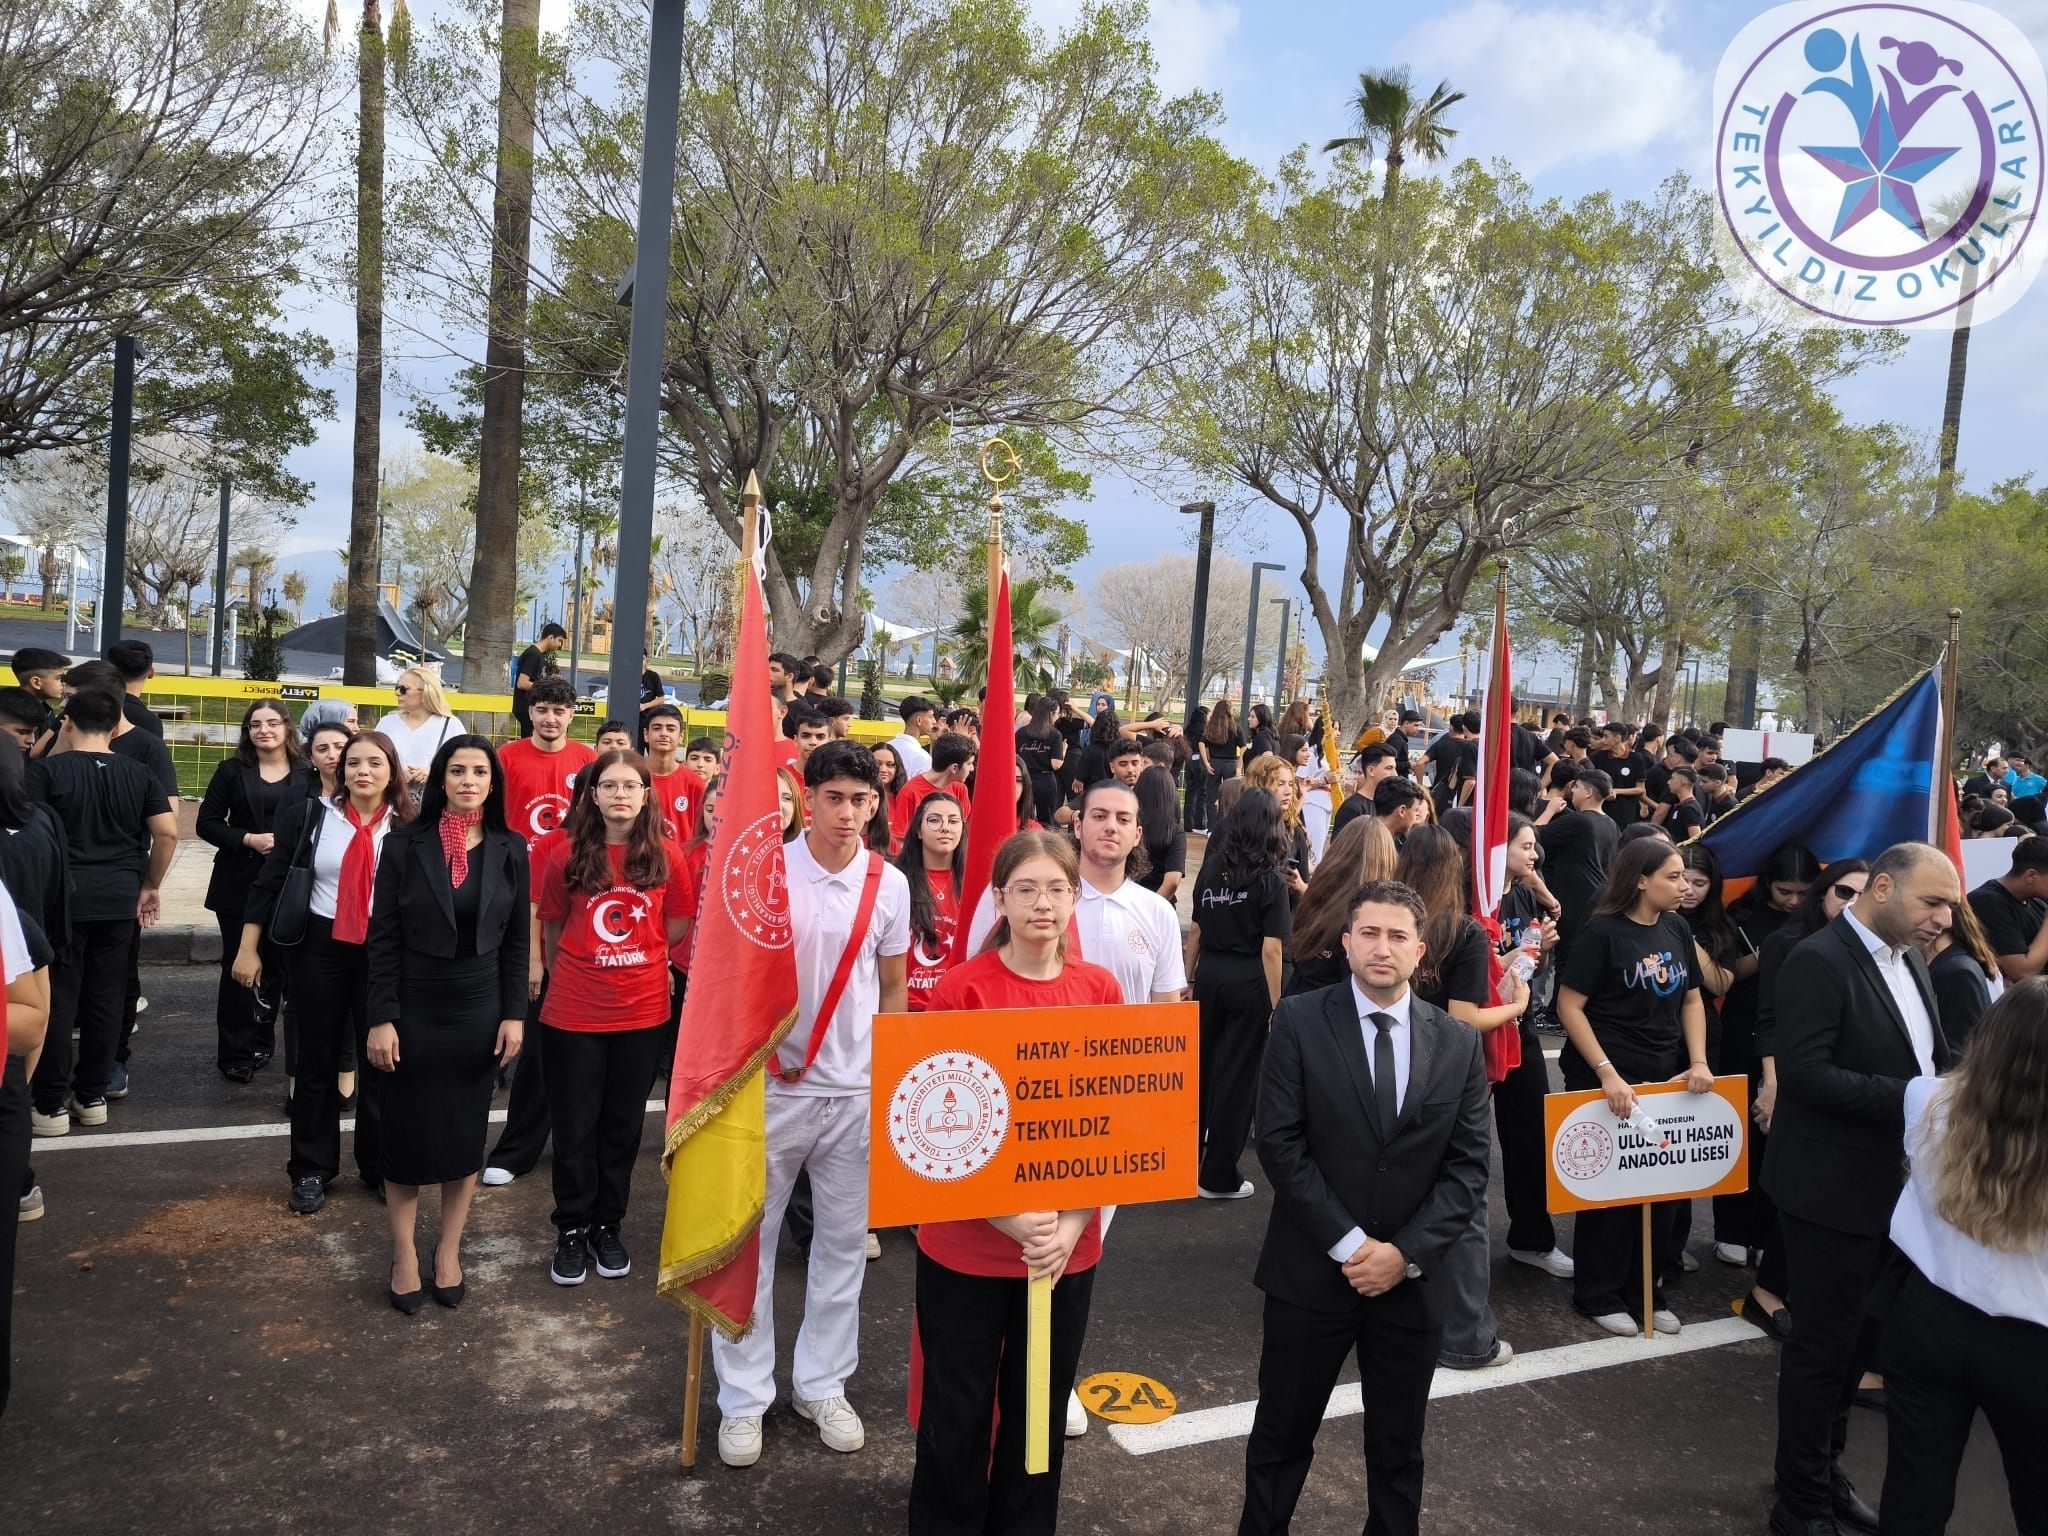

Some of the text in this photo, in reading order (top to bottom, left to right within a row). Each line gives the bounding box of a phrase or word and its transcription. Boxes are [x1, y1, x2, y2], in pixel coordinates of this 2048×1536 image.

[573, 704, 594, 712] SAFE
[907, 975, 941, 989] ATAT
[1016, 1040, 1070, 1060] HATAY
[1084, 1035, 1187, 1057] İSKENDERUN
[1015, 1071, 1184, 1101] ÖZEL İSKENDERUN
[909, 1073, 945, 1127] CUMHURİYETİ
[1015, 1116, 1111, 1141] TEKYILDIZ
[1655, 1115, 1695, 1125] ENDERUN
[910, 1129, 940, 1158] TÜRKİYE
[1618, 1124, 1734, 1149] ULUTLI HASAN
[1014, 1147, 1166, 1183] ANADOLU LİSESİ
[1618, 1149, 1686, 1170] ANADOLU
[1691, 1141, 1729, 1163] LİSESİ
[1089, 1382, 1172, 1412] 24
